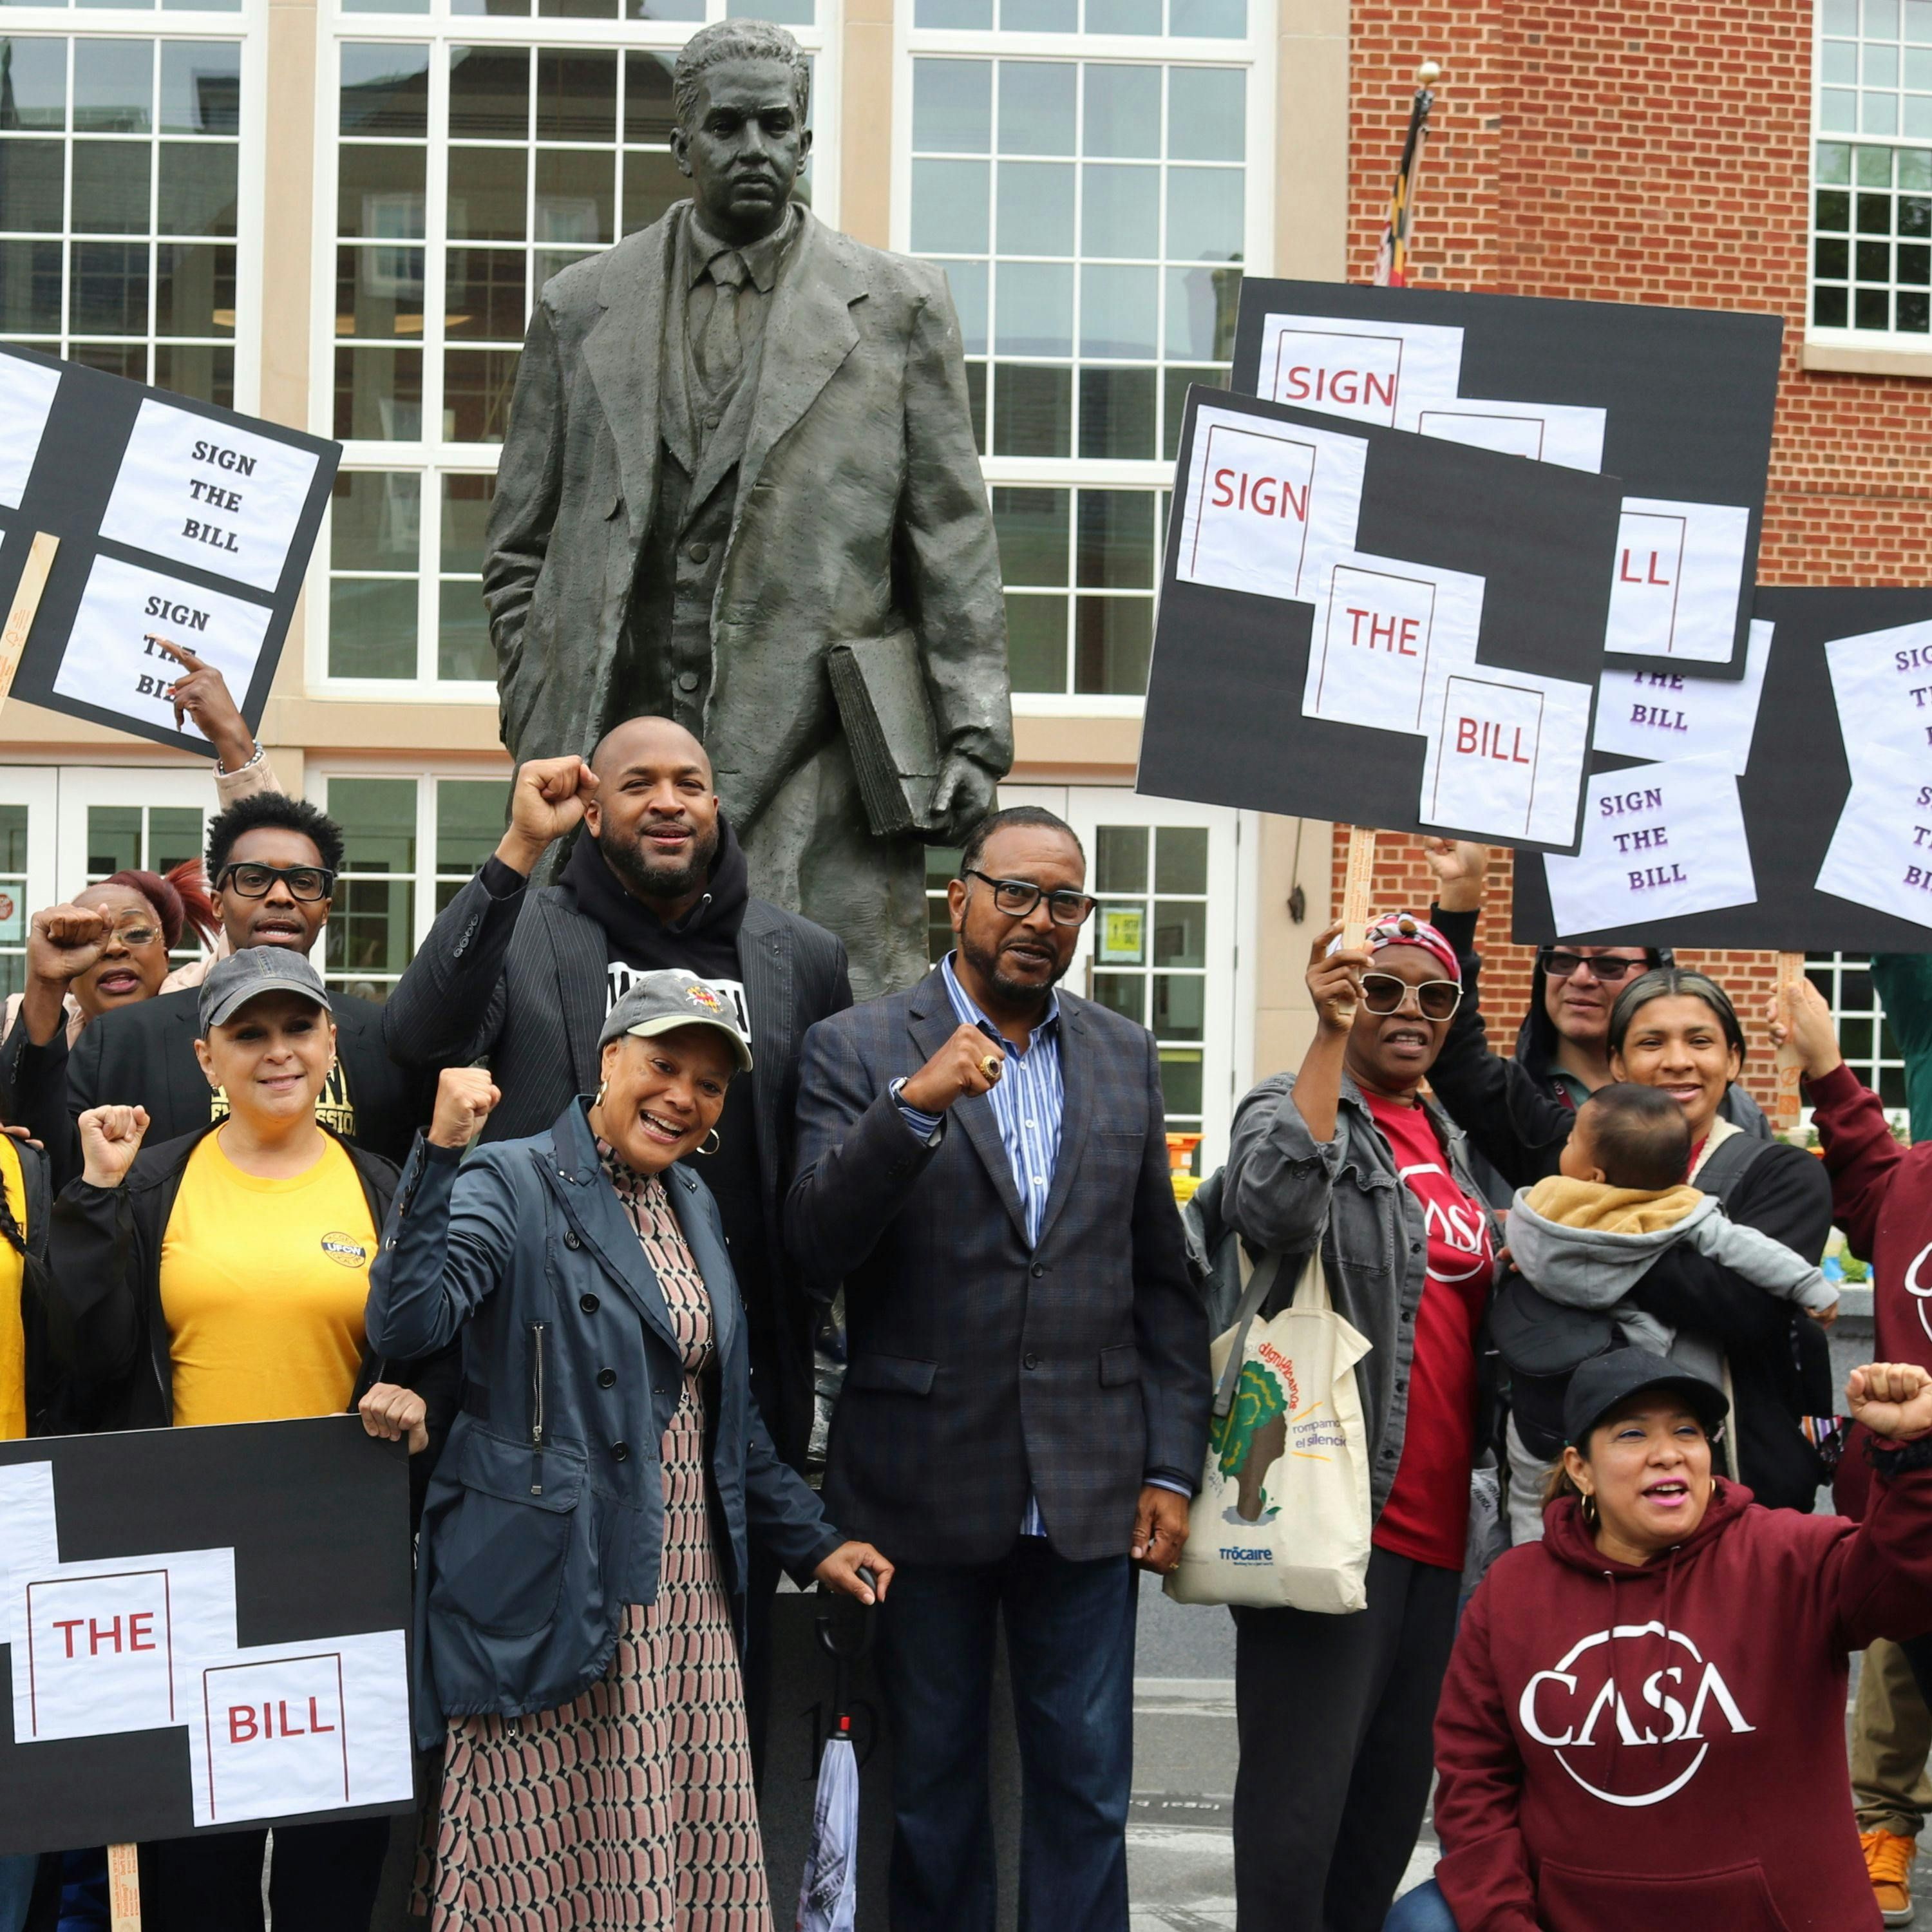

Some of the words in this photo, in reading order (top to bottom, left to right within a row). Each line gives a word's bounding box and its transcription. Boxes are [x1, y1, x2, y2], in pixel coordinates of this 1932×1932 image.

[1285, 365, 1396, 406] SIGN
[192, 440, 257, 477] SIGN
[189, 479, 242, 513] THE
[1211, 468, 1307, 522] SIGN
[182, 518, 239, 553] BILL
[145, 596, 211, 632] SIGN
[1347, 607, 1420, 657] THE
[1630, 704, 1689, 732] BILL
[1456, 717, 1530, 764] BILL
[1600, 788, 1663, 817] SIGN
[1613, 826, 1669, 853] THE
[1627, 863, 1687, 891] BILL
[327, 1243, 361, 1255] UFCW
[1296, 1437, 1305, 1448] el
[53, 1612, 156, 1658] THE
[228, 1696, 335, 1743] BILL
[1519, 1662, 1756, 1747] CASA
